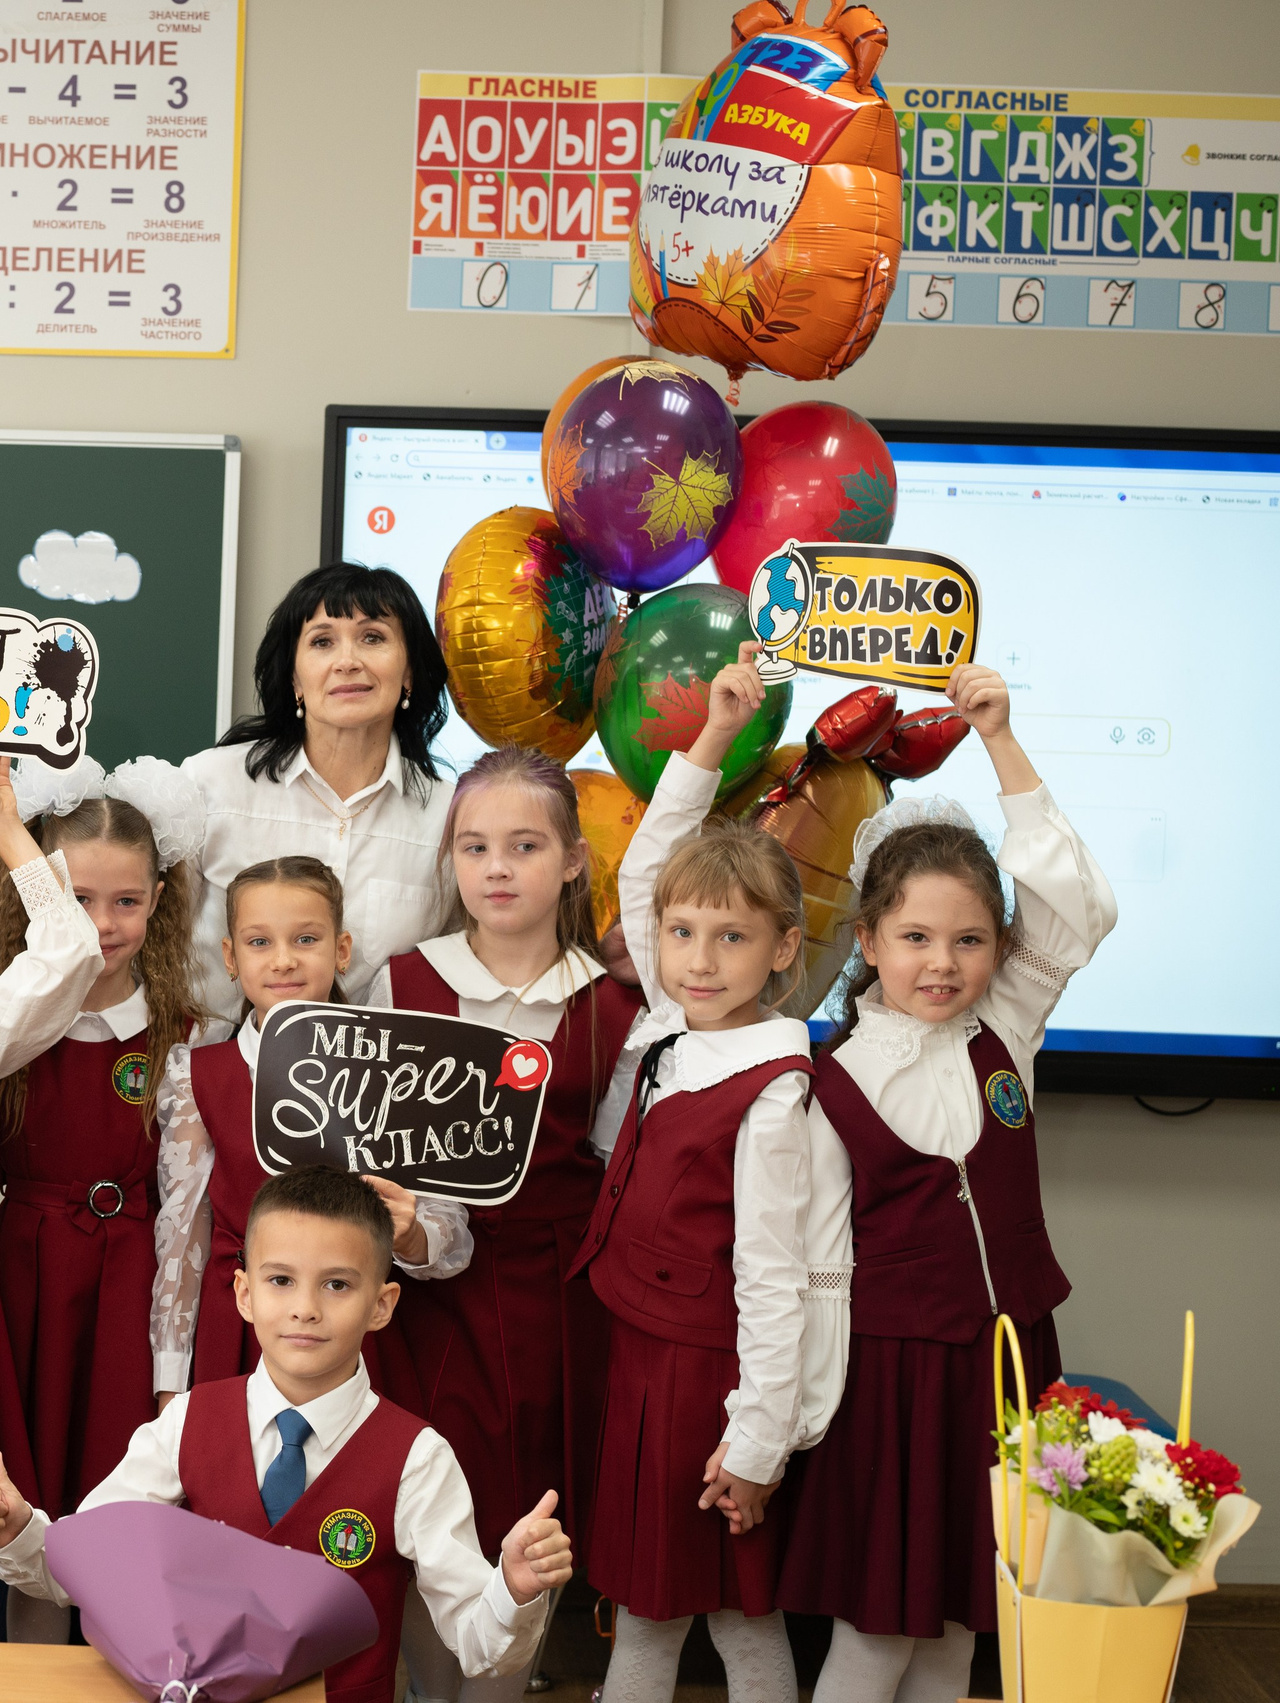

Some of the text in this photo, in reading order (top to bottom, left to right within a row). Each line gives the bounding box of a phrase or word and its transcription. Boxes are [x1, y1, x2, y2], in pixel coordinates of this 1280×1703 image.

[37, 12, 106, 22] СЛАГАЕМОЕ
[149, 11, 210, 20] ЗНАЧЕНИЕ
[157, 24, 201, 33] СУММЫ
[741, 41, 825, 79] 123
[58, 75, 81, 107] 4
[114, 84, 136, 100] =
[167, 76, 188, 109] 3
[468, 78, 596, 98] ГЛАСНЫЕ
[904, 89, 1069, 112] СОГЛАСНЫЕ
[29, 116, 109, 126] ВЫЧИТАЕМОЕ
[147, 116, 207, 125] ЗНАЧЕНИЕ
[146, 128, 207, 138] РАЗНОСТИ
[724, 103, 810, 146] АЗБУКА
[665, 150, 740, 191] школу
[748, 161, 786, 184] за
[57, 179, 78, 211] 2
[111, 188, 133, 204] =
[164, 180, 185, 213] 8
[33, 220, 106, 230] МНОЖИТЕЛЬ
[144, 219, 204, 229] ЗНАЧЕНИЕ
[127, 232, 220, 243] ПРОИЗВЕДЕНИЯ
[671, 232, 694, 262] 5+
[9, 285, 15, 308] :
[54, 281, 75, 314] 2
[108, 291, 131, 307] =
[161, 283, 182, 316] 3
[478, 262, 508, 307] 0
[919, 275, 1225, 328] 5 6 7 8
[36, 324, 97, 333] ДЕЛИТЕЛЬ
[142, 318, 201, 328] ЗНАЧЕНИЕ
[141, 330, 202, 340] ЧАСТНОГО
[816, 576, 963, 613] ТОЛЬКО
[808, 625, 966, 665] ВПЕРЕД!
[272, 1056, 500, 1149] Super
[343, 1116, 515, 1173] КЛАСС!
[323, 1512, 363, 1533] ГИМНАЗИЯ
